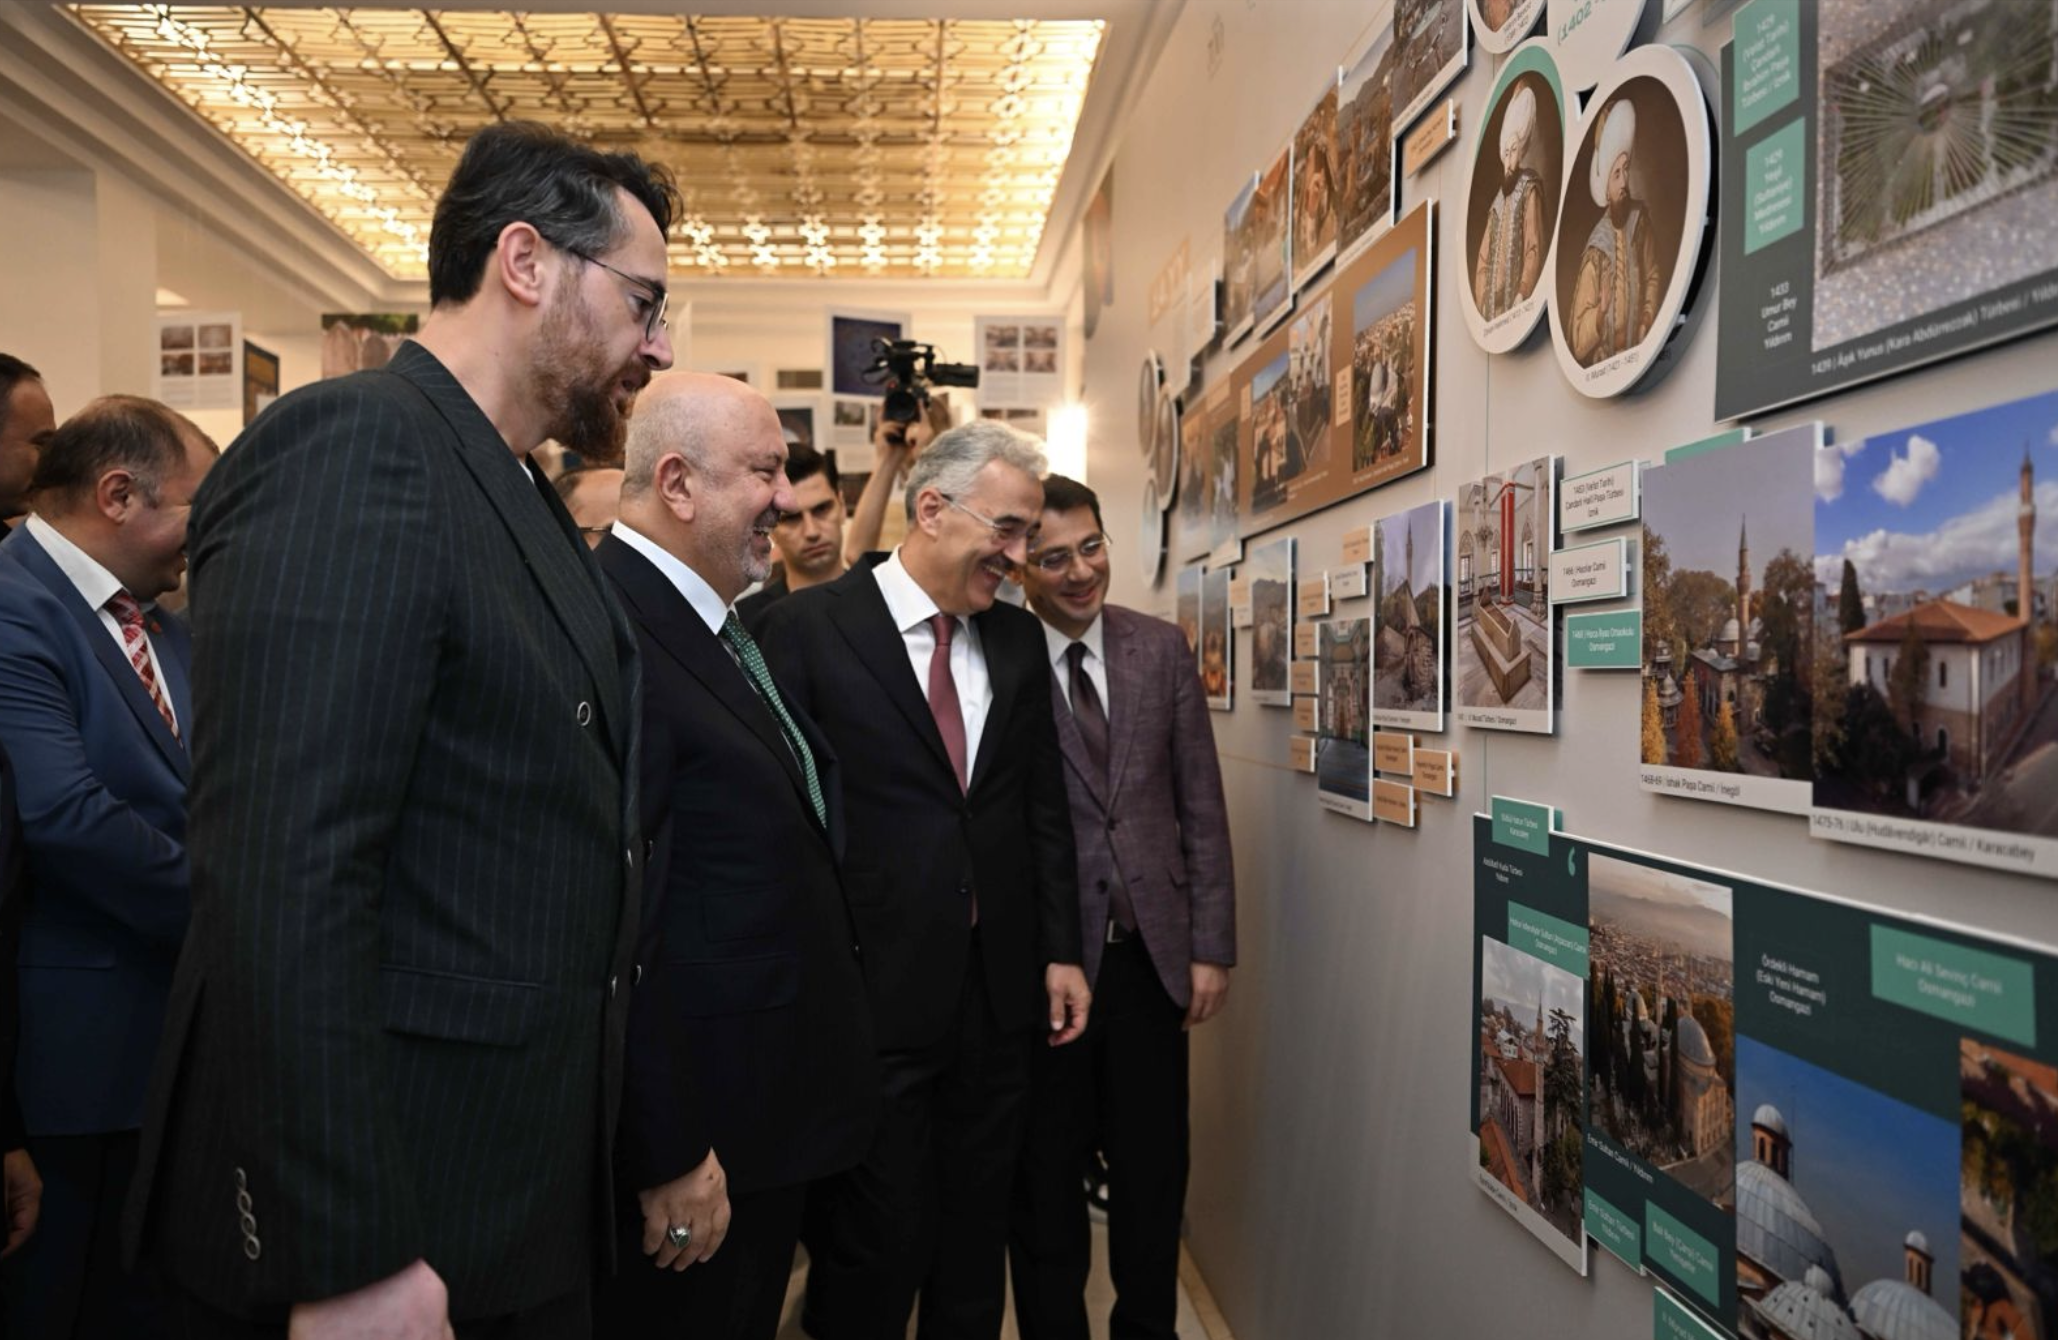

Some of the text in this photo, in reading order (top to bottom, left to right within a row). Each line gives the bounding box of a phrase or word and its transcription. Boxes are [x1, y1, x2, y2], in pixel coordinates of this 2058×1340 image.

[1770, 281, 1790, 299] 1433
[1782, 297, 1798, 311] Bey
[1858, 344, 1884, 361] Yunus
[1938, 833, 1967, 849] Camii
[1977, 838, 2036, 863] Karacabey
[1789, 963, 1819, 984] Hamam
[1756, 969, 1827, 1006] (Eski Yeni Hamam)
[1917, 979, 1976, 1008] Osmangazi
[1768, 990, 1812, 1016] Osmangazi
